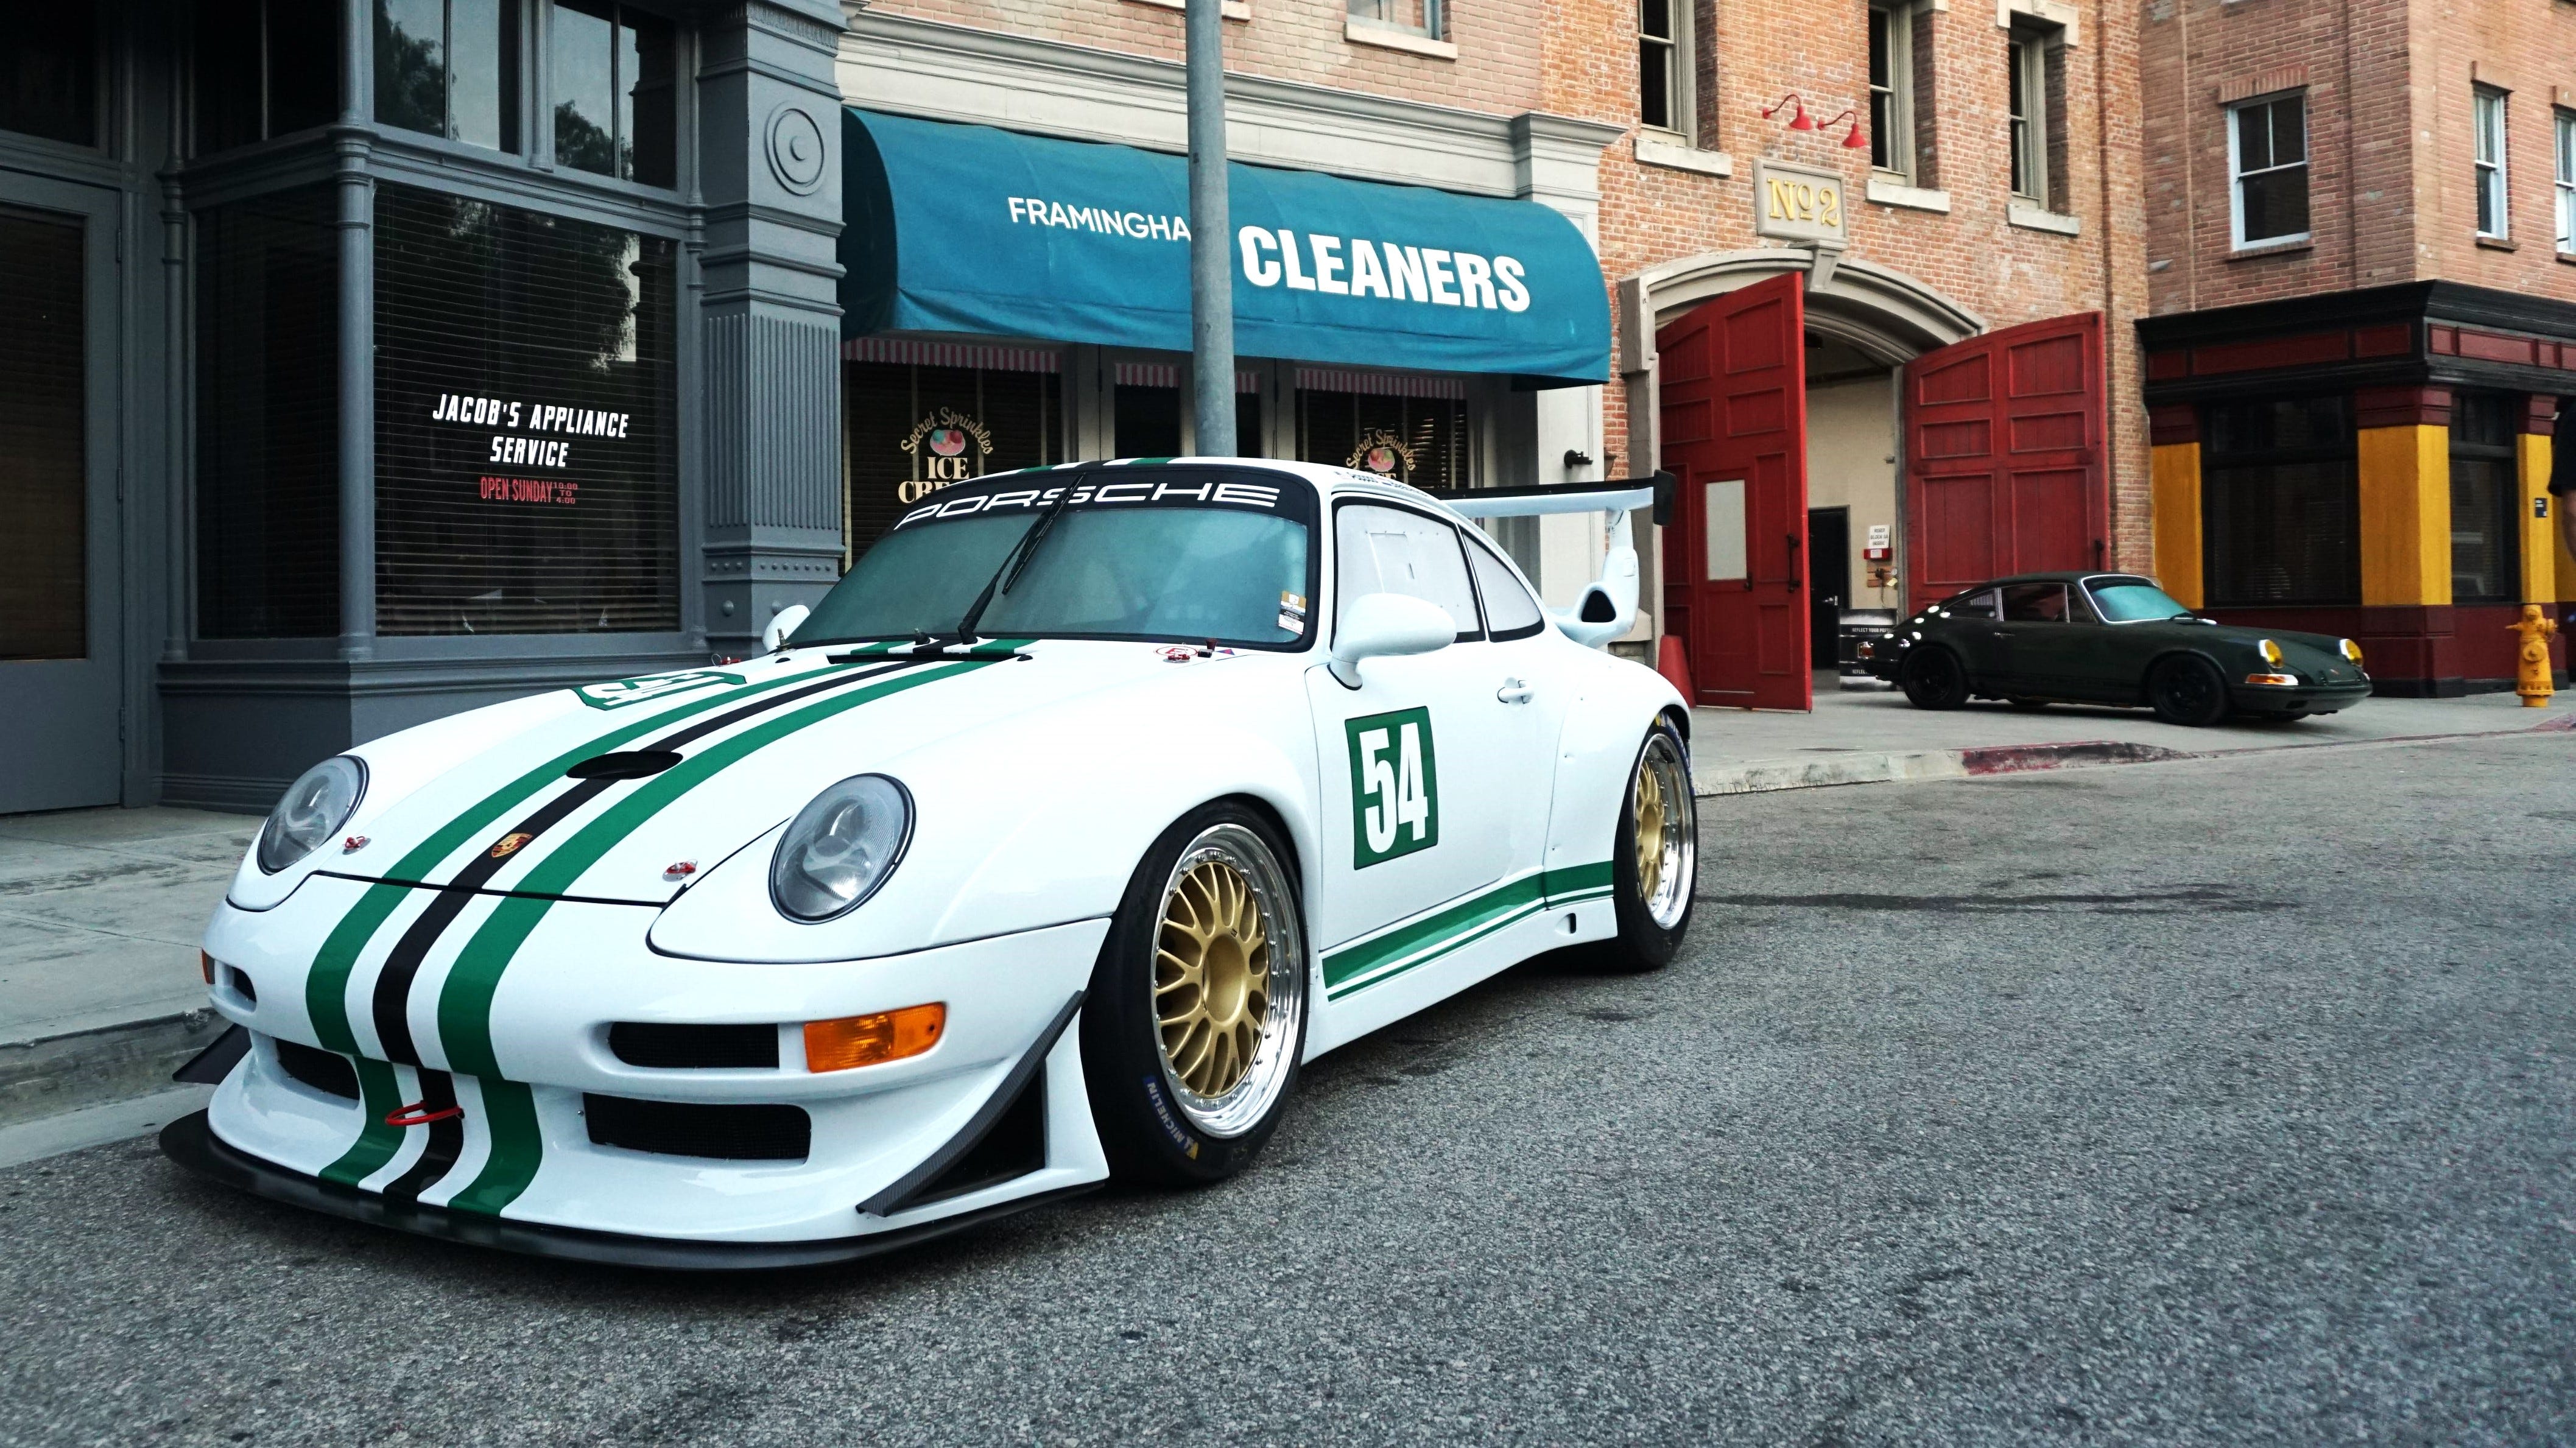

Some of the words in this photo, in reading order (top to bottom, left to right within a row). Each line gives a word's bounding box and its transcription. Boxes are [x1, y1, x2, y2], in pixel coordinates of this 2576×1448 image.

[1008, 197, 1191, 241] FRAMINGHA
[1819, 188, 1840, 227] 2
[1239, 226, 1530, 312] CLEANERS
[432, 393, 521, 427] JACOB'S
[529, 404, 629, 438] APPLIANCE
[901, 411, 938, 454] Secret
[940, 406, 994, 455] Sprinkles
[490, 436, 569, 467] SERVICE
[927, 456, 970, 480] ICE
[1345, 433, 1374, 469] Secret
[1375, 429, 1417, 471] Sprinkles
[480, 476, 509, 500] OPEN
[512, 478, 552, 503] SUNDAY
[553, 482, 578, 490] 10:00
[893, 482, 1280, 531] PORSCHE
[1359, 722, 1429, 854] 54
[1147, 1083, 1185, 1143] MICHELIN
